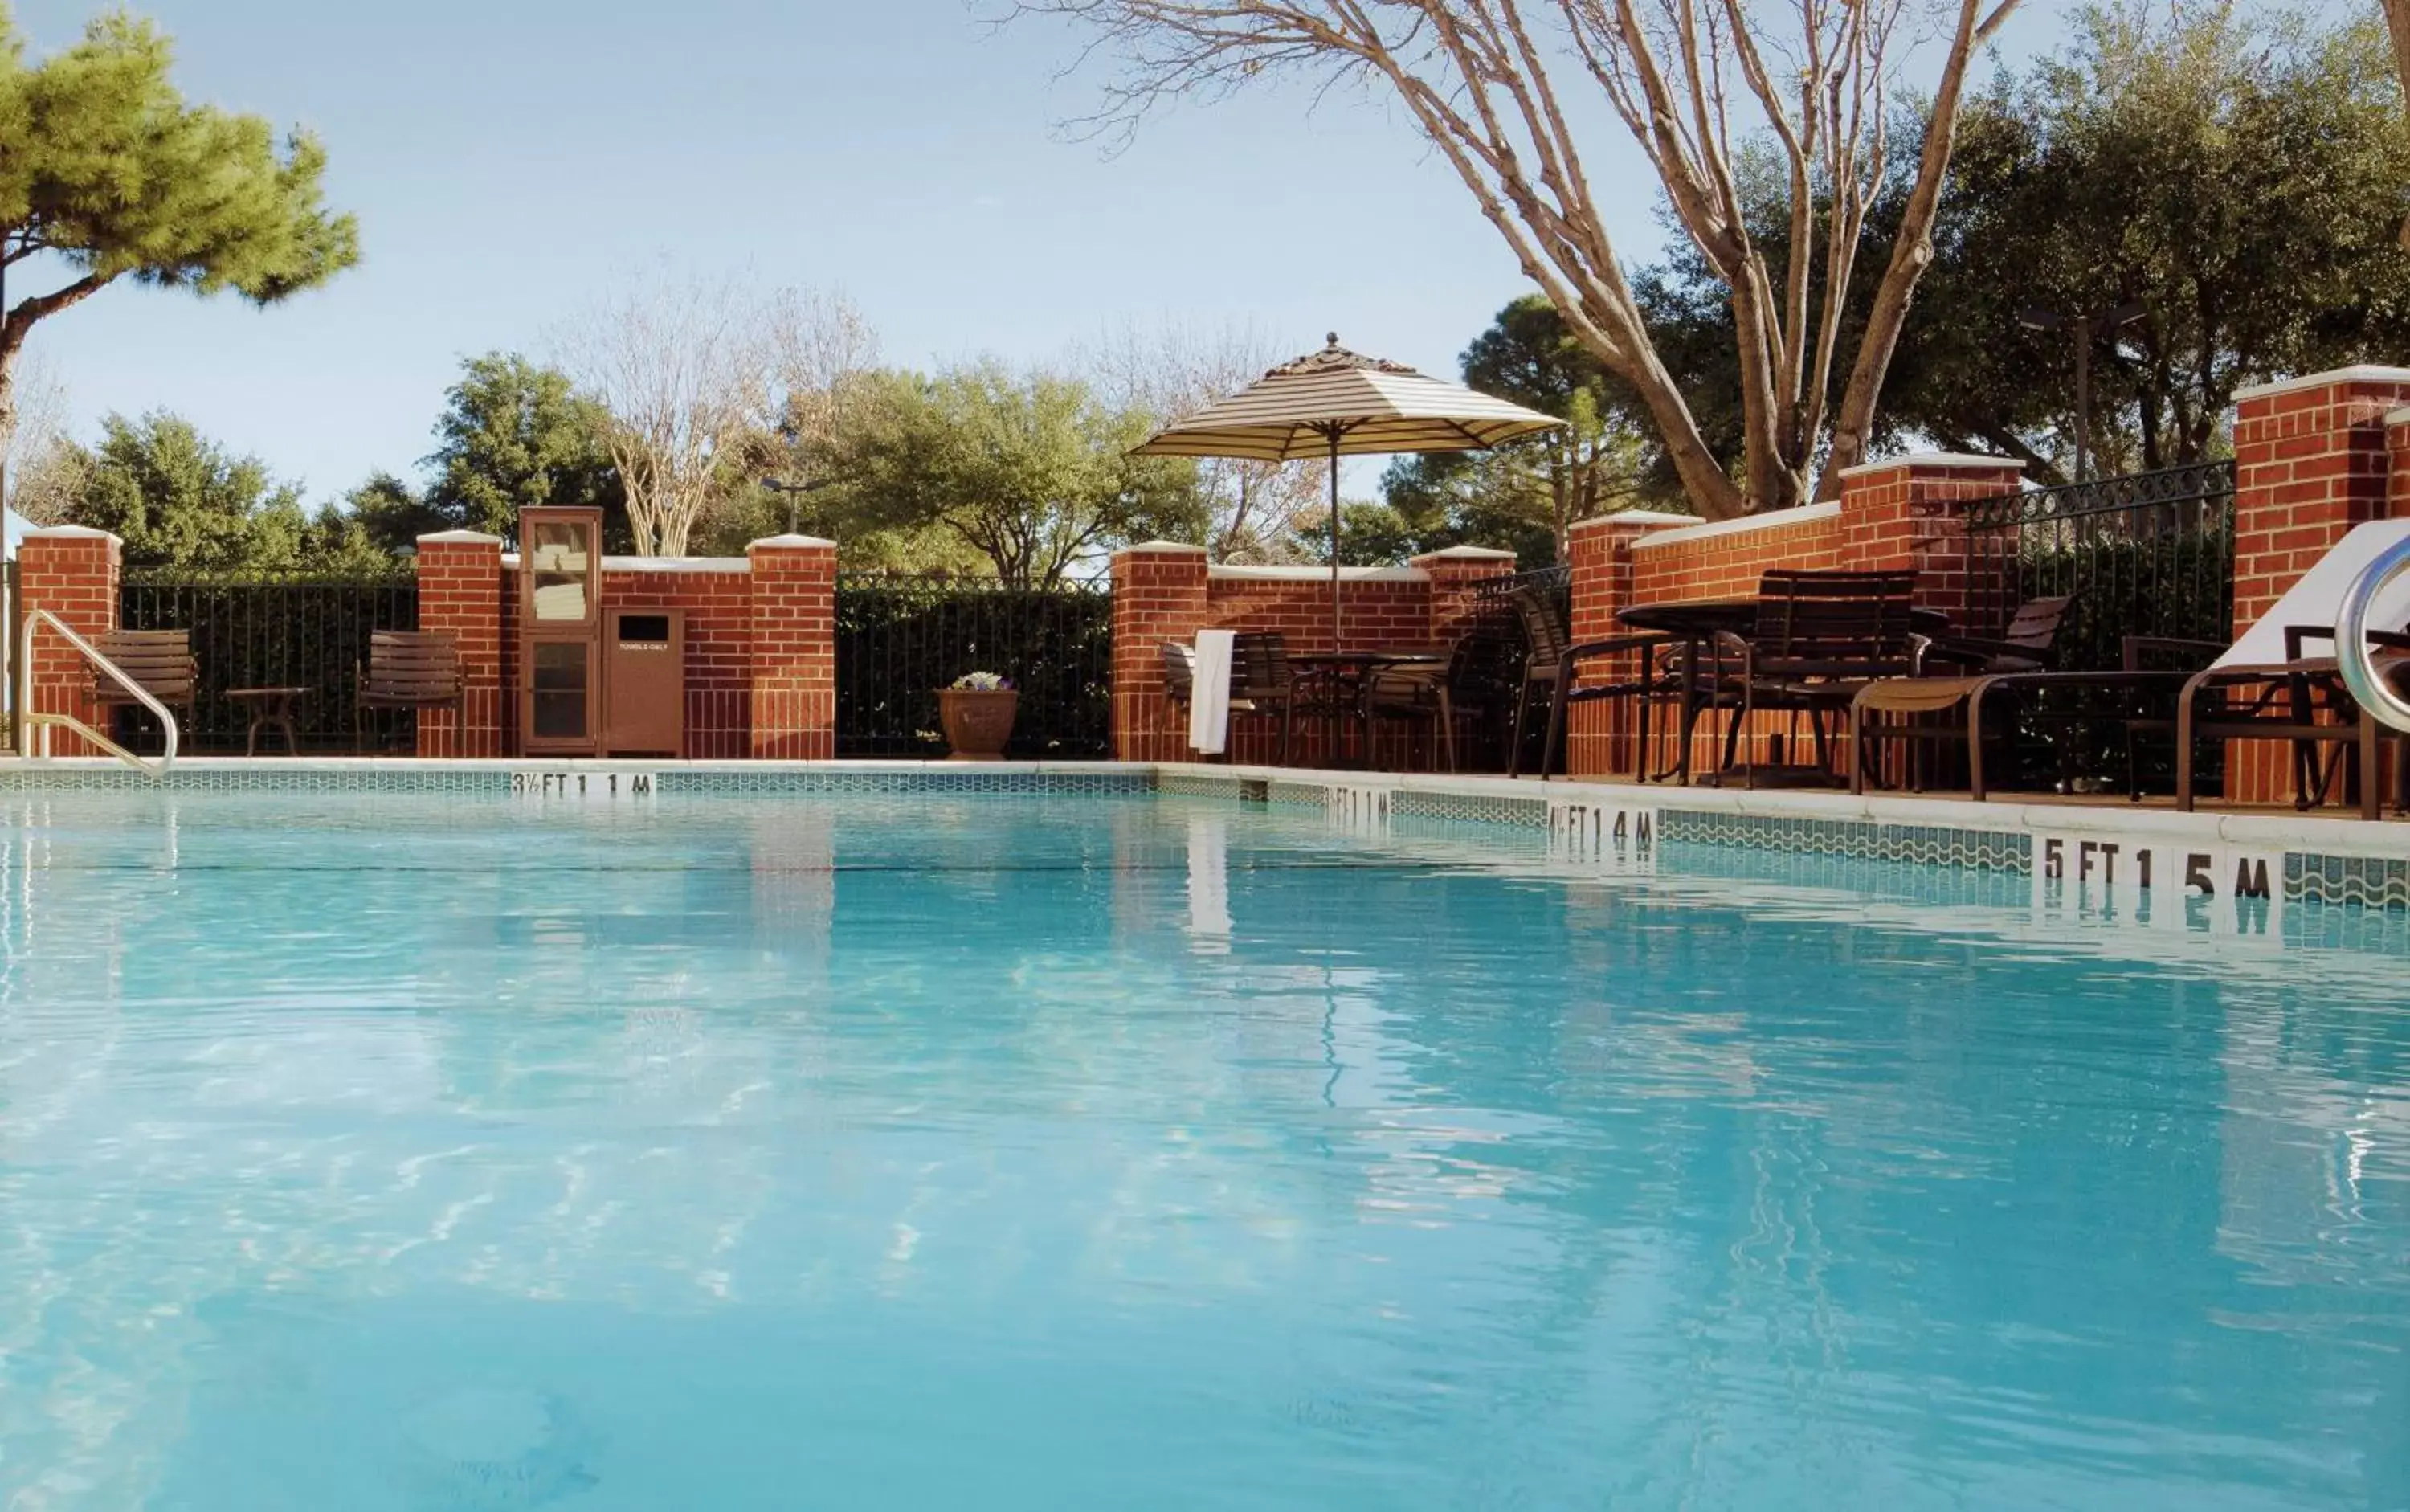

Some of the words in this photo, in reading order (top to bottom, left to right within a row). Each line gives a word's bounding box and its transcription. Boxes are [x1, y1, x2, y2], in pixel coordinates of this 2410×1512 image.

[542, 774, 567, 793] FT
[578, 774, 586, 791] 1
[608, 774, 617, 791] 1
[632, 774, 650, 792] M
[1613, 811, 1628, 838] 4
[1636, 811, 1651, 842] M
[2045, 839, 2064, 878] 5
[2079, 841, 2119, 883] FT
[2136, 849, 2151, 888] 1
[2185, 853, 2215, 894] 5
[2235, 857, 2270, 901] M
